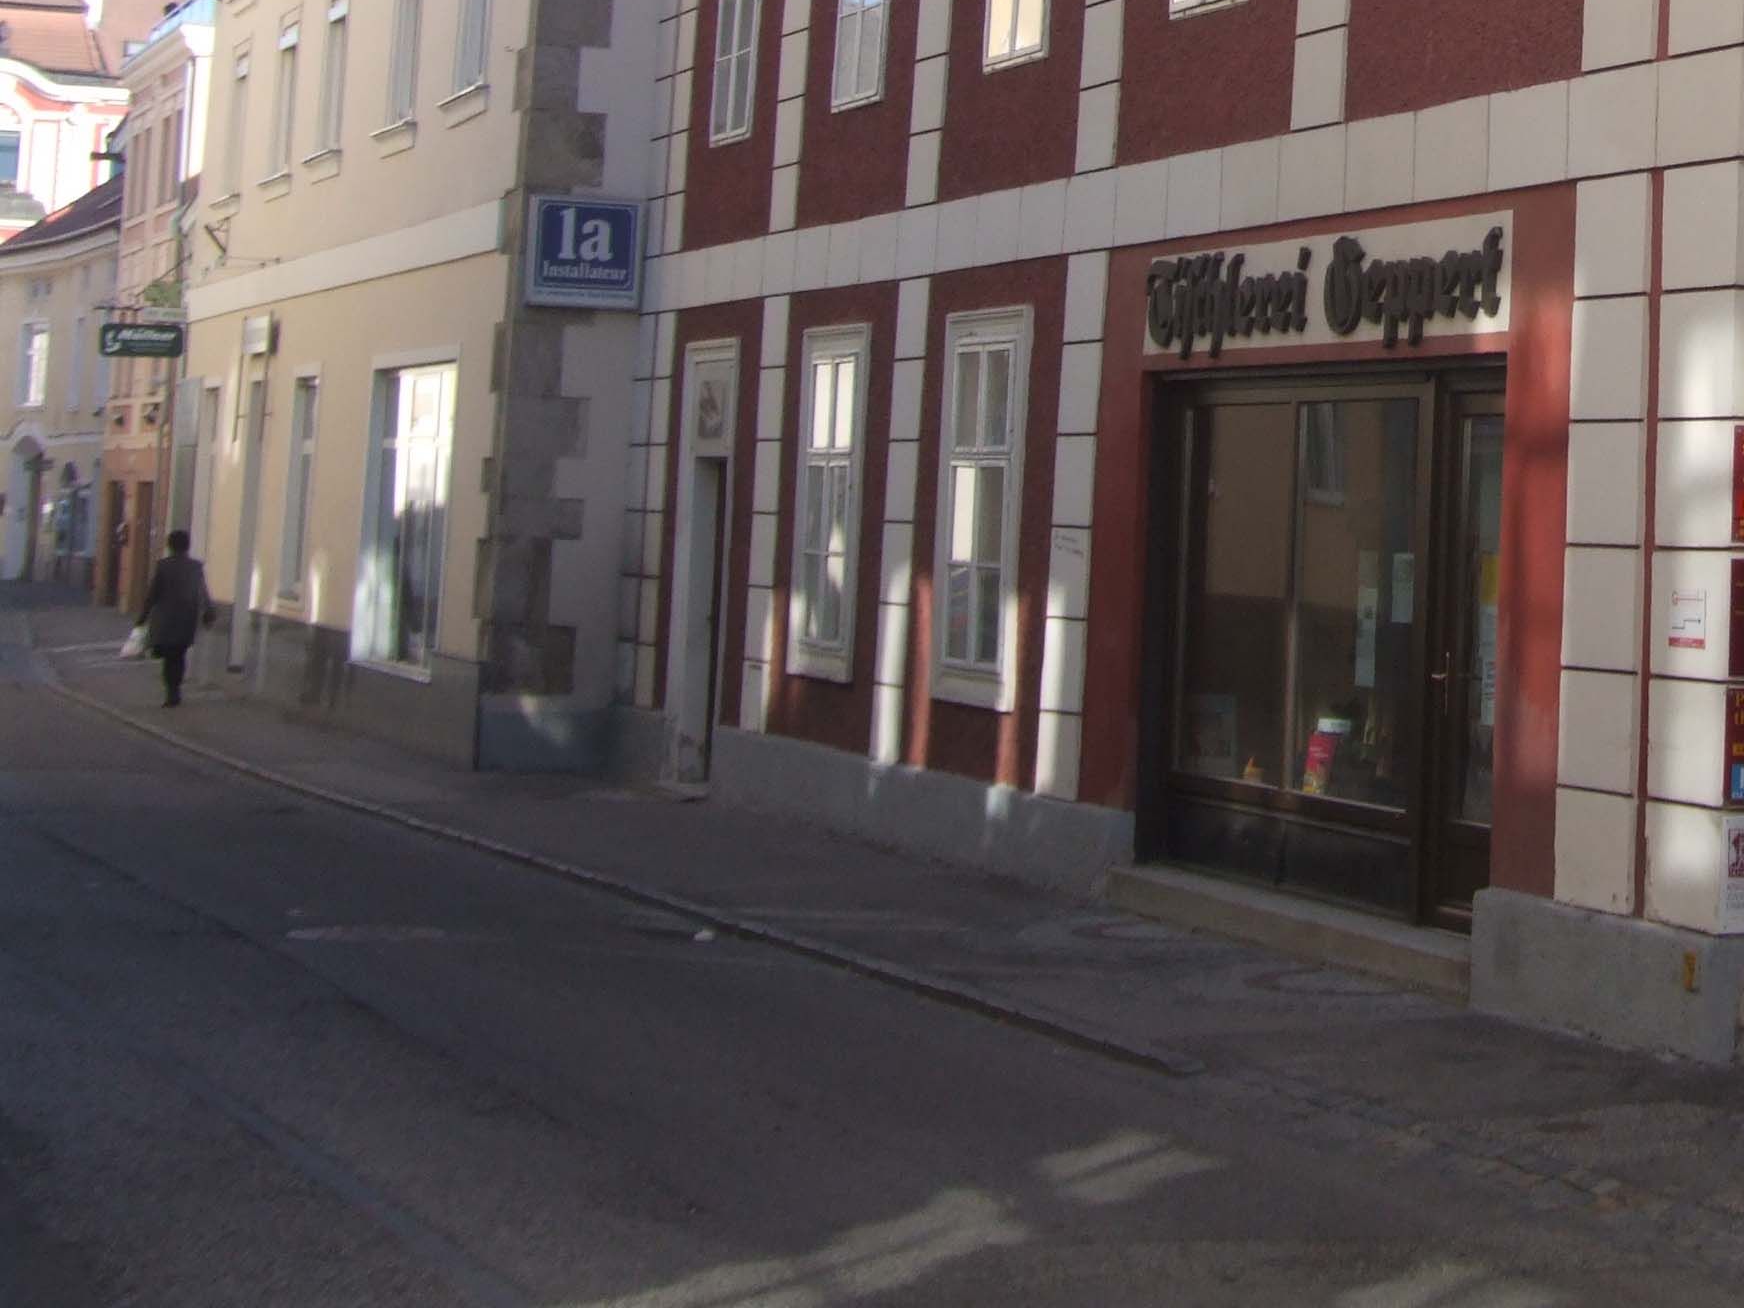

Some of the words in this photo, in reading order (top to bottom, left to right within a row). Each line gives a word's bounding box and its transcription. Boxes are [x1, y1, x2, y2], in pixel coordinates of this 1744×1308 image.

[557, 206, 614, 262] 1a
[543, 259, 627, 281] Installateur
[1324, 226, 1504, 349] Geppert
